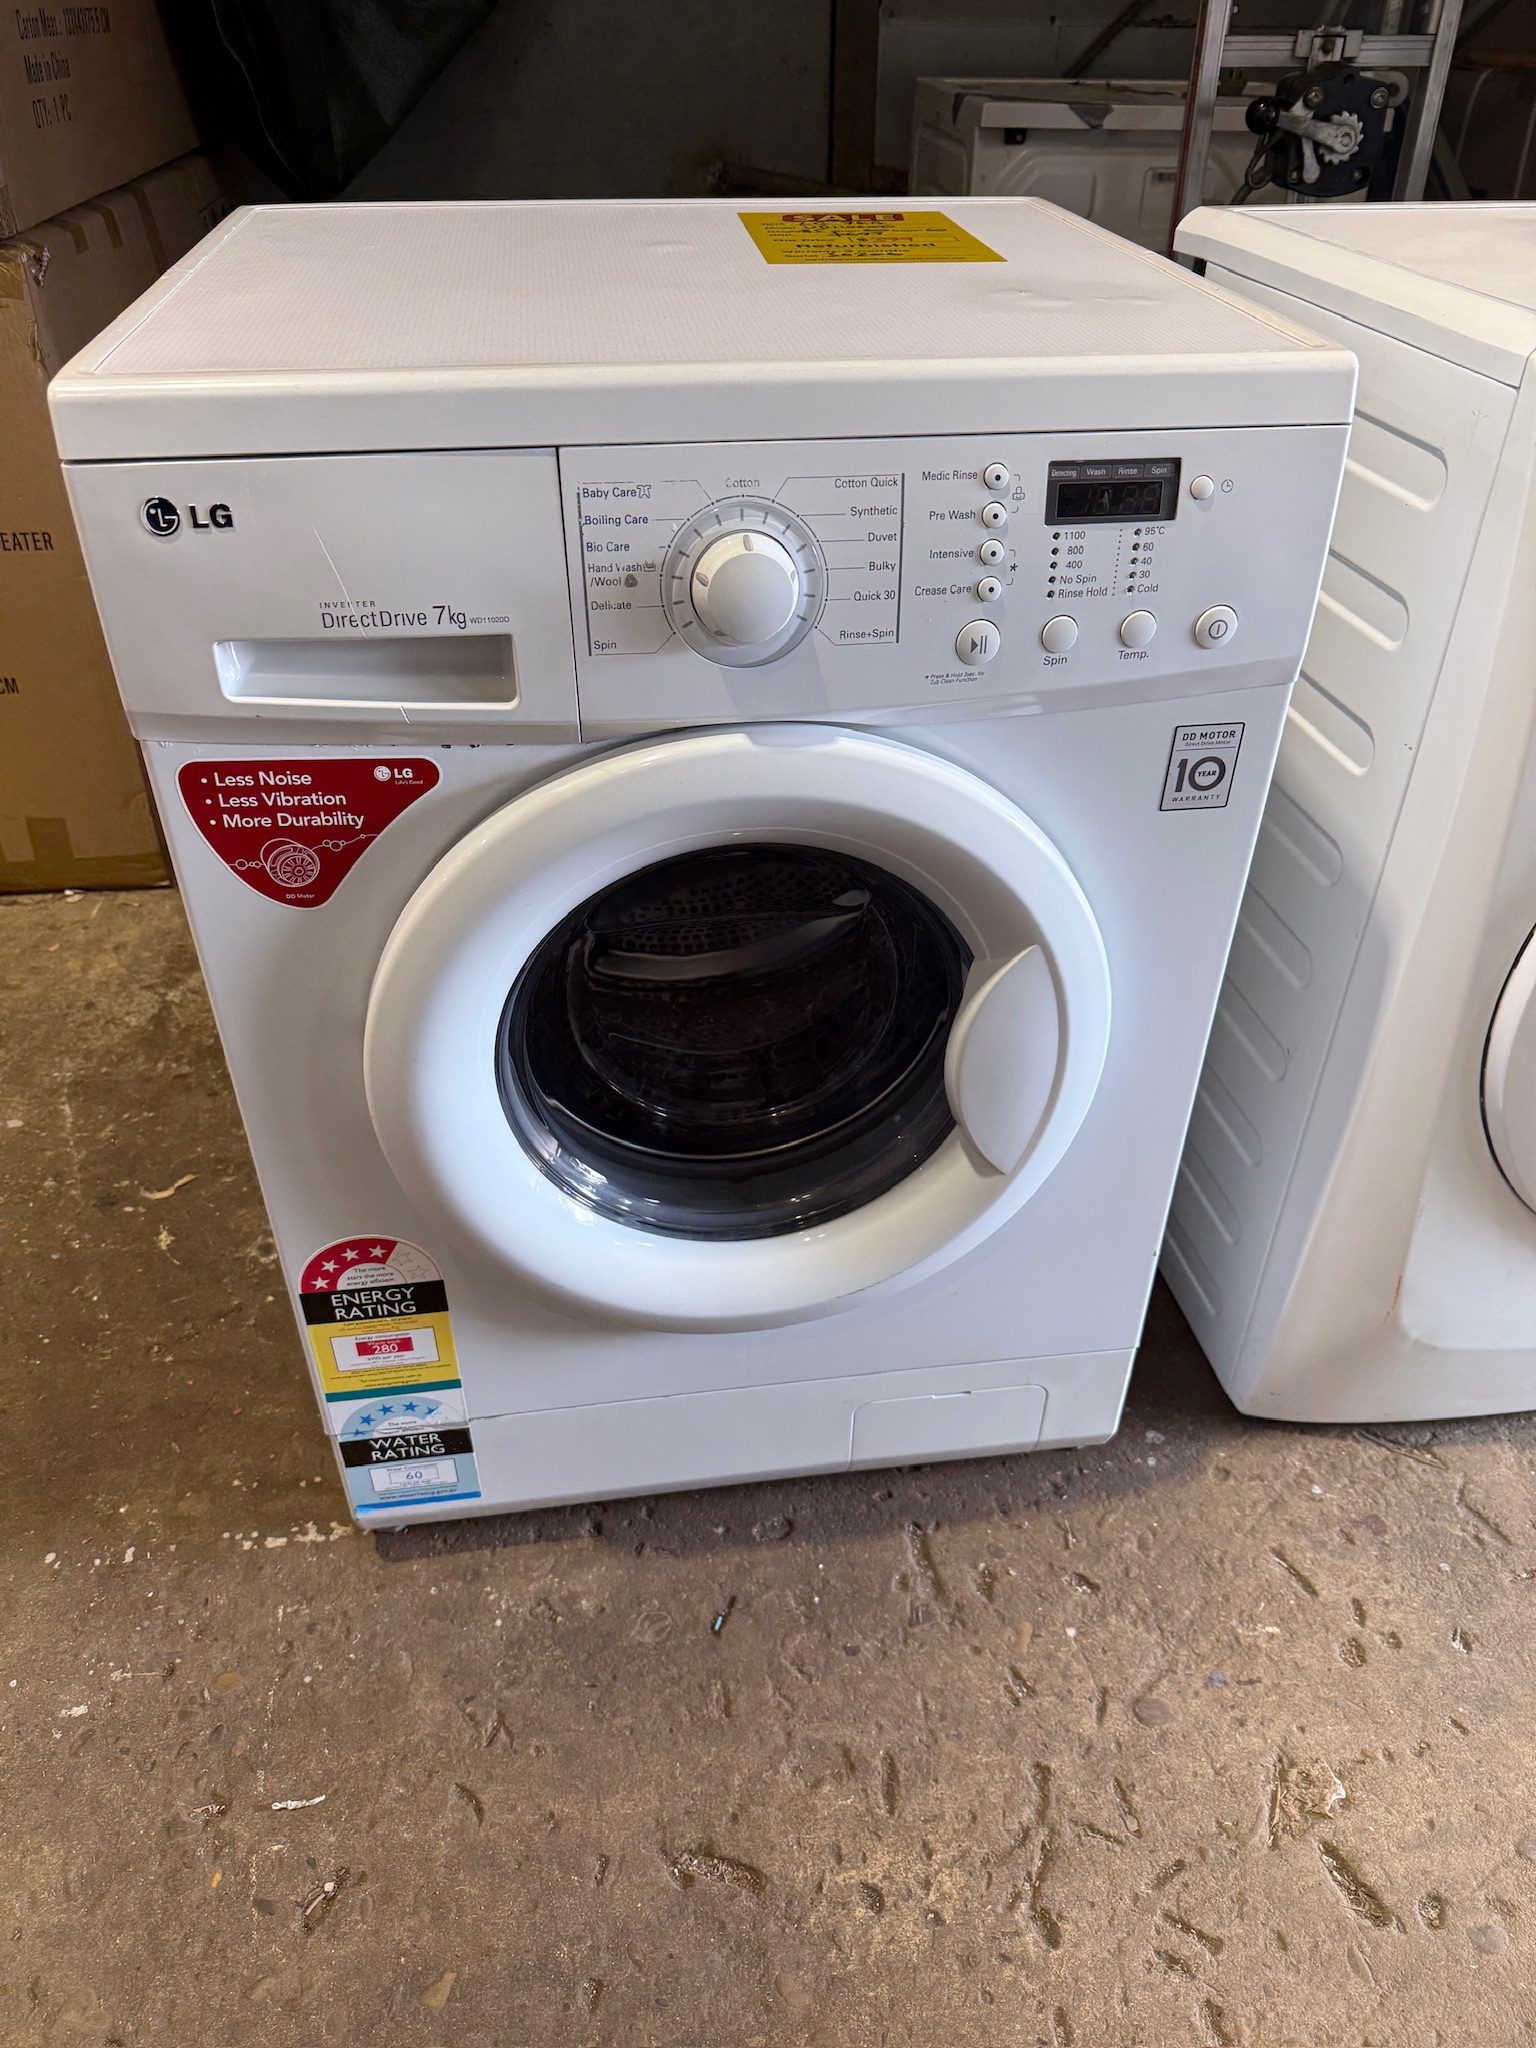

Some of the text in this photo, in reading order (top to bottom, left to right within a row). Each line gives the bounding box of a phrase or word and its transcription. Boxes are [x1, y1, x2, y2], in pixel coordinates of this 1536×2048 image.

[15, 8, 41, 40] Carton
[23, 53, 44, 84] Made
[50, 51, 70, 80] China
[32, 93, 72, 129] QTY: 1 PC
[792, 213, 896, 222] SALE
[921, 469, 978, 481] Medic Rinse
[1051, 468, 1077, 478] Detecting
[1086, 467, 1106, 476] Wash
[1118, 466, 1138, 475] Rinse
[1151, 465, 1168, 475] Spin
[725, 477, 760, 488] Cotton
[834, 477, 899, 489] Cotton Quick
[582, 487, 637, 500] Baby Care
[187, 501, 235, 530] LG
[850, 506, 898, 518] Synthetic
[929, 509, 976, 521] Pre Wash
[584, 514, 649, 527] Boiling Care
[867, 531, 897, 542] Duvet
[1064, 530, 1086, 540] 1100
[586, 541, 630, 552] Bio Care
[1067, 545, 1084, 555] 800
[1142, 542, 1154, 551] 60
[929, 548, 974, 559] Intensive
[869, 561, 897, 572] Bulky
[1065, 560, 1083, 569] 400
[1140, 556, 1152, 565] 40
[587, 563, 613, 573] Hand
[1059, 573, 1097, 585] No Spin
[1139, 570, 1151, 579] 30
[590, 576, 622, 588] /Wool
[1137, 583, 1159, 593] Cold
[853, 589, 896, 601] Quick 30
[914, 584, 972, 597] Crease Care
[1058, 586, 1108, 599] Rinse Hold
[431, 604, 467, 630] 7kg
[469, 616, 510, 624] WD11020D
[839, 629, 894, 640] Rinse+Spin
[593, 640, 617, 651] Spin
[1043, 654, 1068, 668] Spin
[1118, 649, 1150, 661] Temp.
[1182, 730, 1236, 741] DD MOTOR
[213, 770, 312, 787] Less Noise
[394, 767, 414, 779] LG
[1174, 756, 1226, 793] 10
[217, 791, 347, 809] Less Vibration
[1171, 793, 1221, 802] WARRANTY
[222, 811, 365, 830] More Durability
[330, 1286, 415, 1307] ENERGY
[335, 1300, 417, 1321] RATING
[371, 1343, 399, 1354] 280
[370, 1433, 442, 1449] WATER
[371, 1443, 446, 1461] RATING
[406, 1470, 423, 1480] 60
